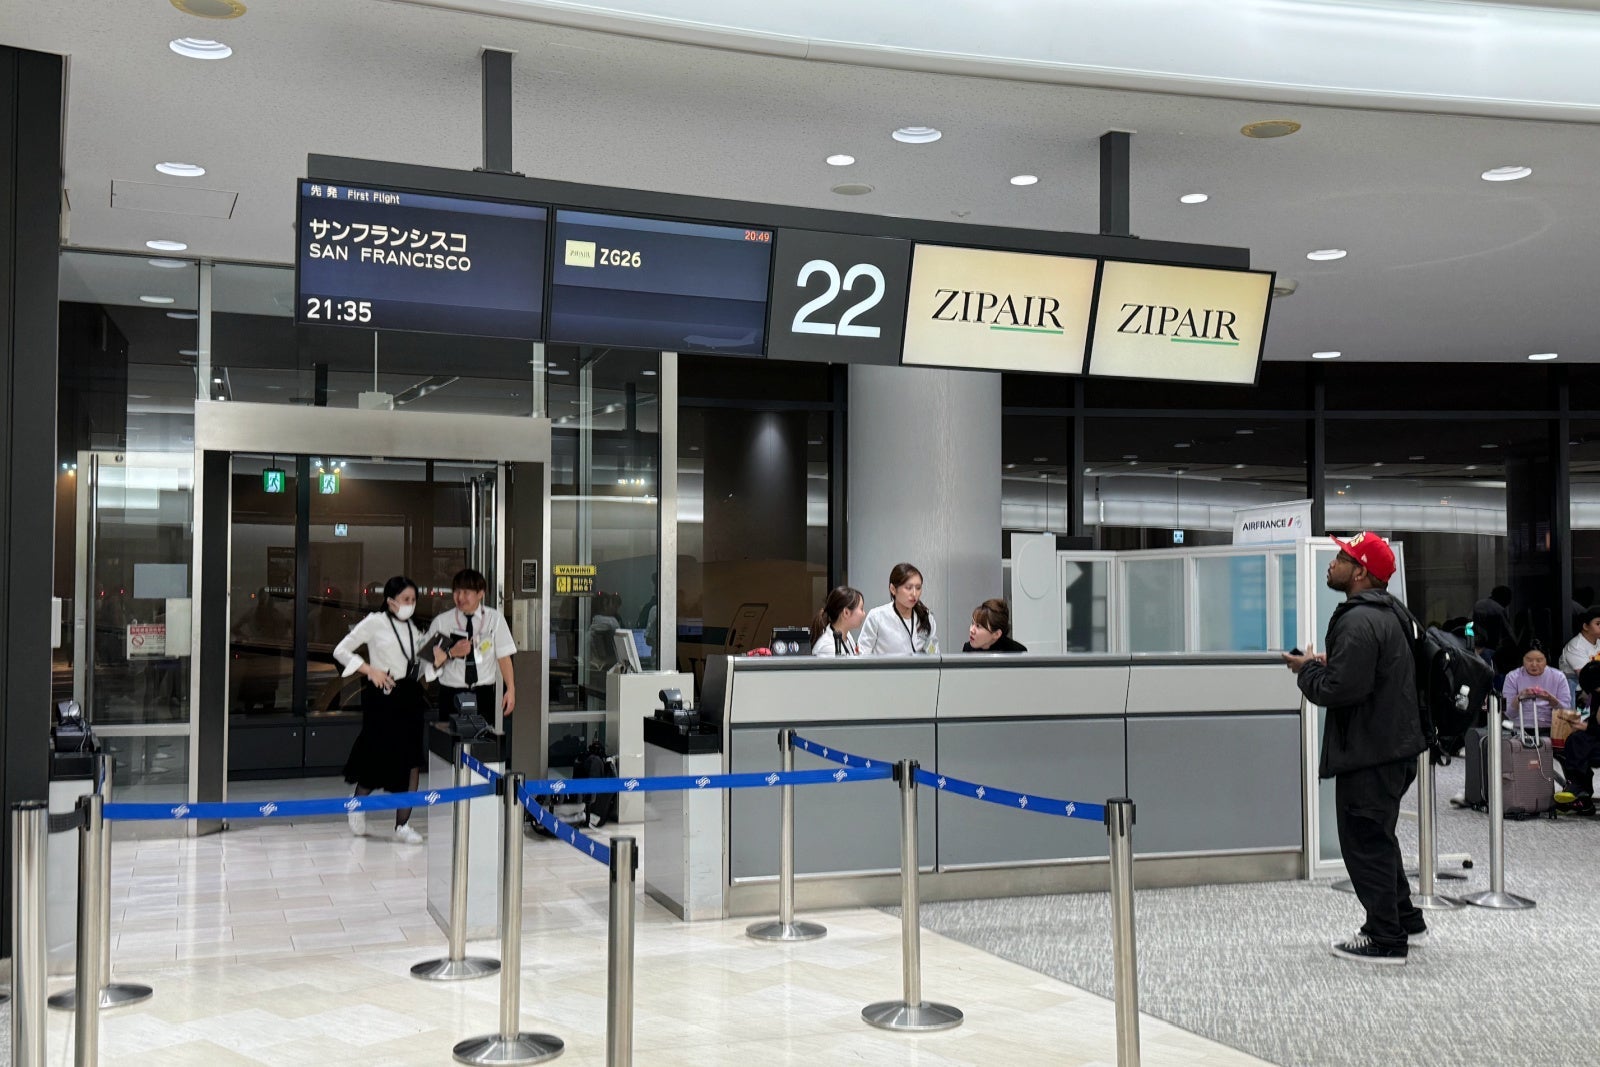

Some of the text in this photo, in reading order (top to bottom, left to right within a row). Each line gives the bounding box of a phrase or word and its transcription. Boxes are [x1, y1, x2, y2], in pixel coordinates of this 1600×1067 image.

[347, 189, 400, 205] First Flight
[309, 218, 467, 252] サンフランシスコ
[744, 230, 770, 243] 20:49
[309, 243, 472, 271] SAN FRANCISCO
[599, 247, 642, 268] ZG26
[306, 297, 372, 322] 21:35
[791, 259, 886, 338] 22
[932, 288, 1064, 329] ZIPAIR
[1117, 303, 1240, 341] ZIPAIR
[1242, 519, 1286, 531] AIRFRANCE
